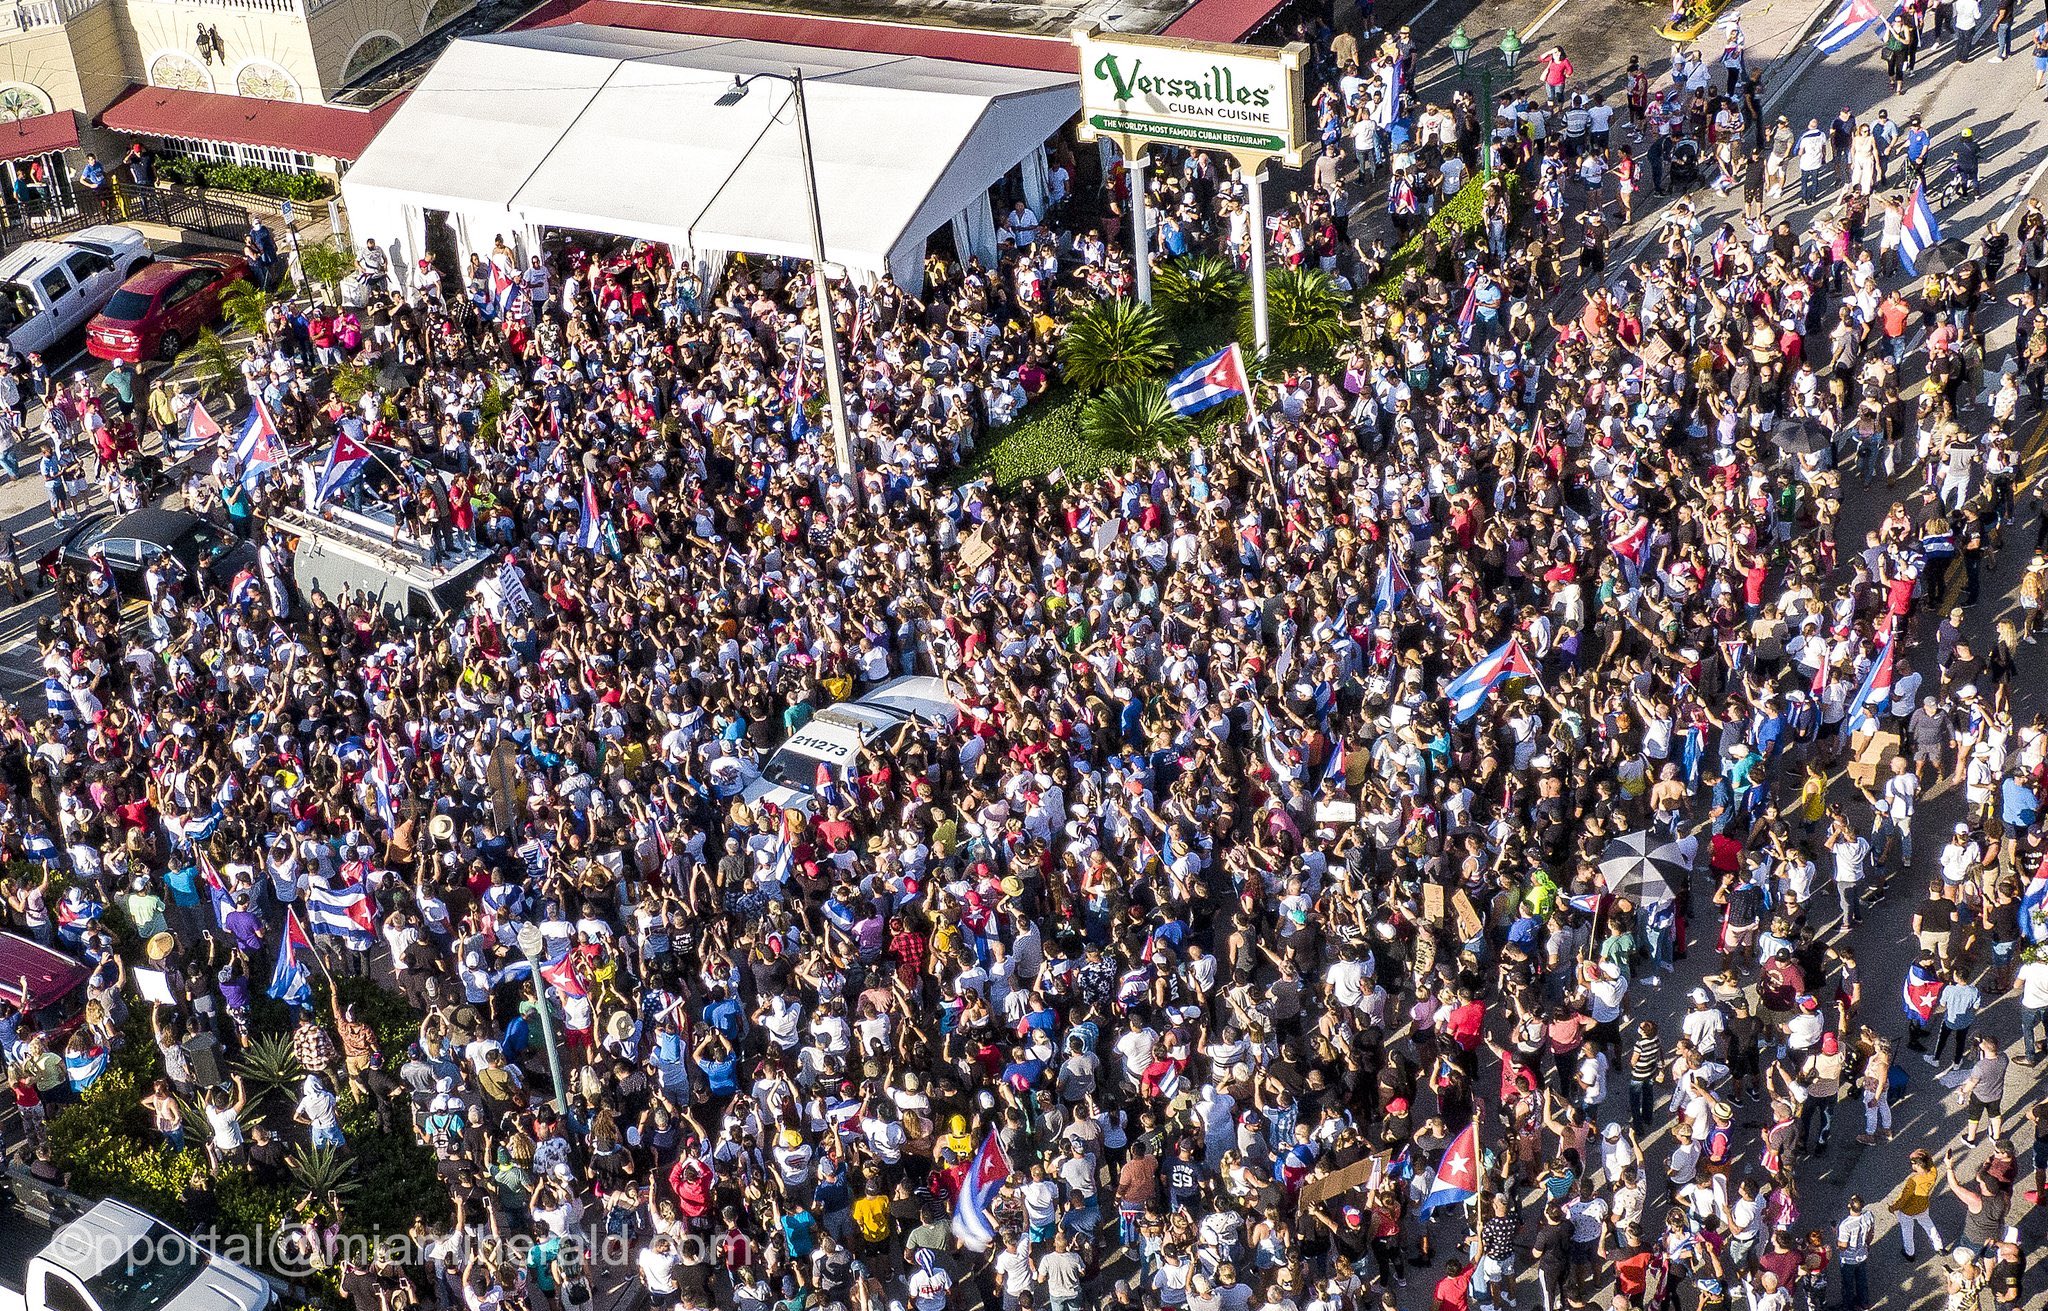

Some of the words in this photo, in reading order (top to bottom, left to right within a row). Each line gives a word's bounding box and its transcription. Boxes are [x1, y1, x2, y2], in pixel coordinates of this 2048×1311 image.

[1094, 52, 1270, 107] Versailles
[1168, 102, 1214, 117] CUBAN
[1217, 109, 1271, 124] CUISINE
[1103, 118, 1117, 128] THE
[1118, 120, 1149, 132] WORLD'S
[1149, 124, 1168, 135] MOST
[1169, 127, 1198, 138] FAMOUS
[1198, 130, 1222, 141] CUBAN
[792, 735, 848, 757] 211273
[1172, 1172, 1193, 1188] 99
